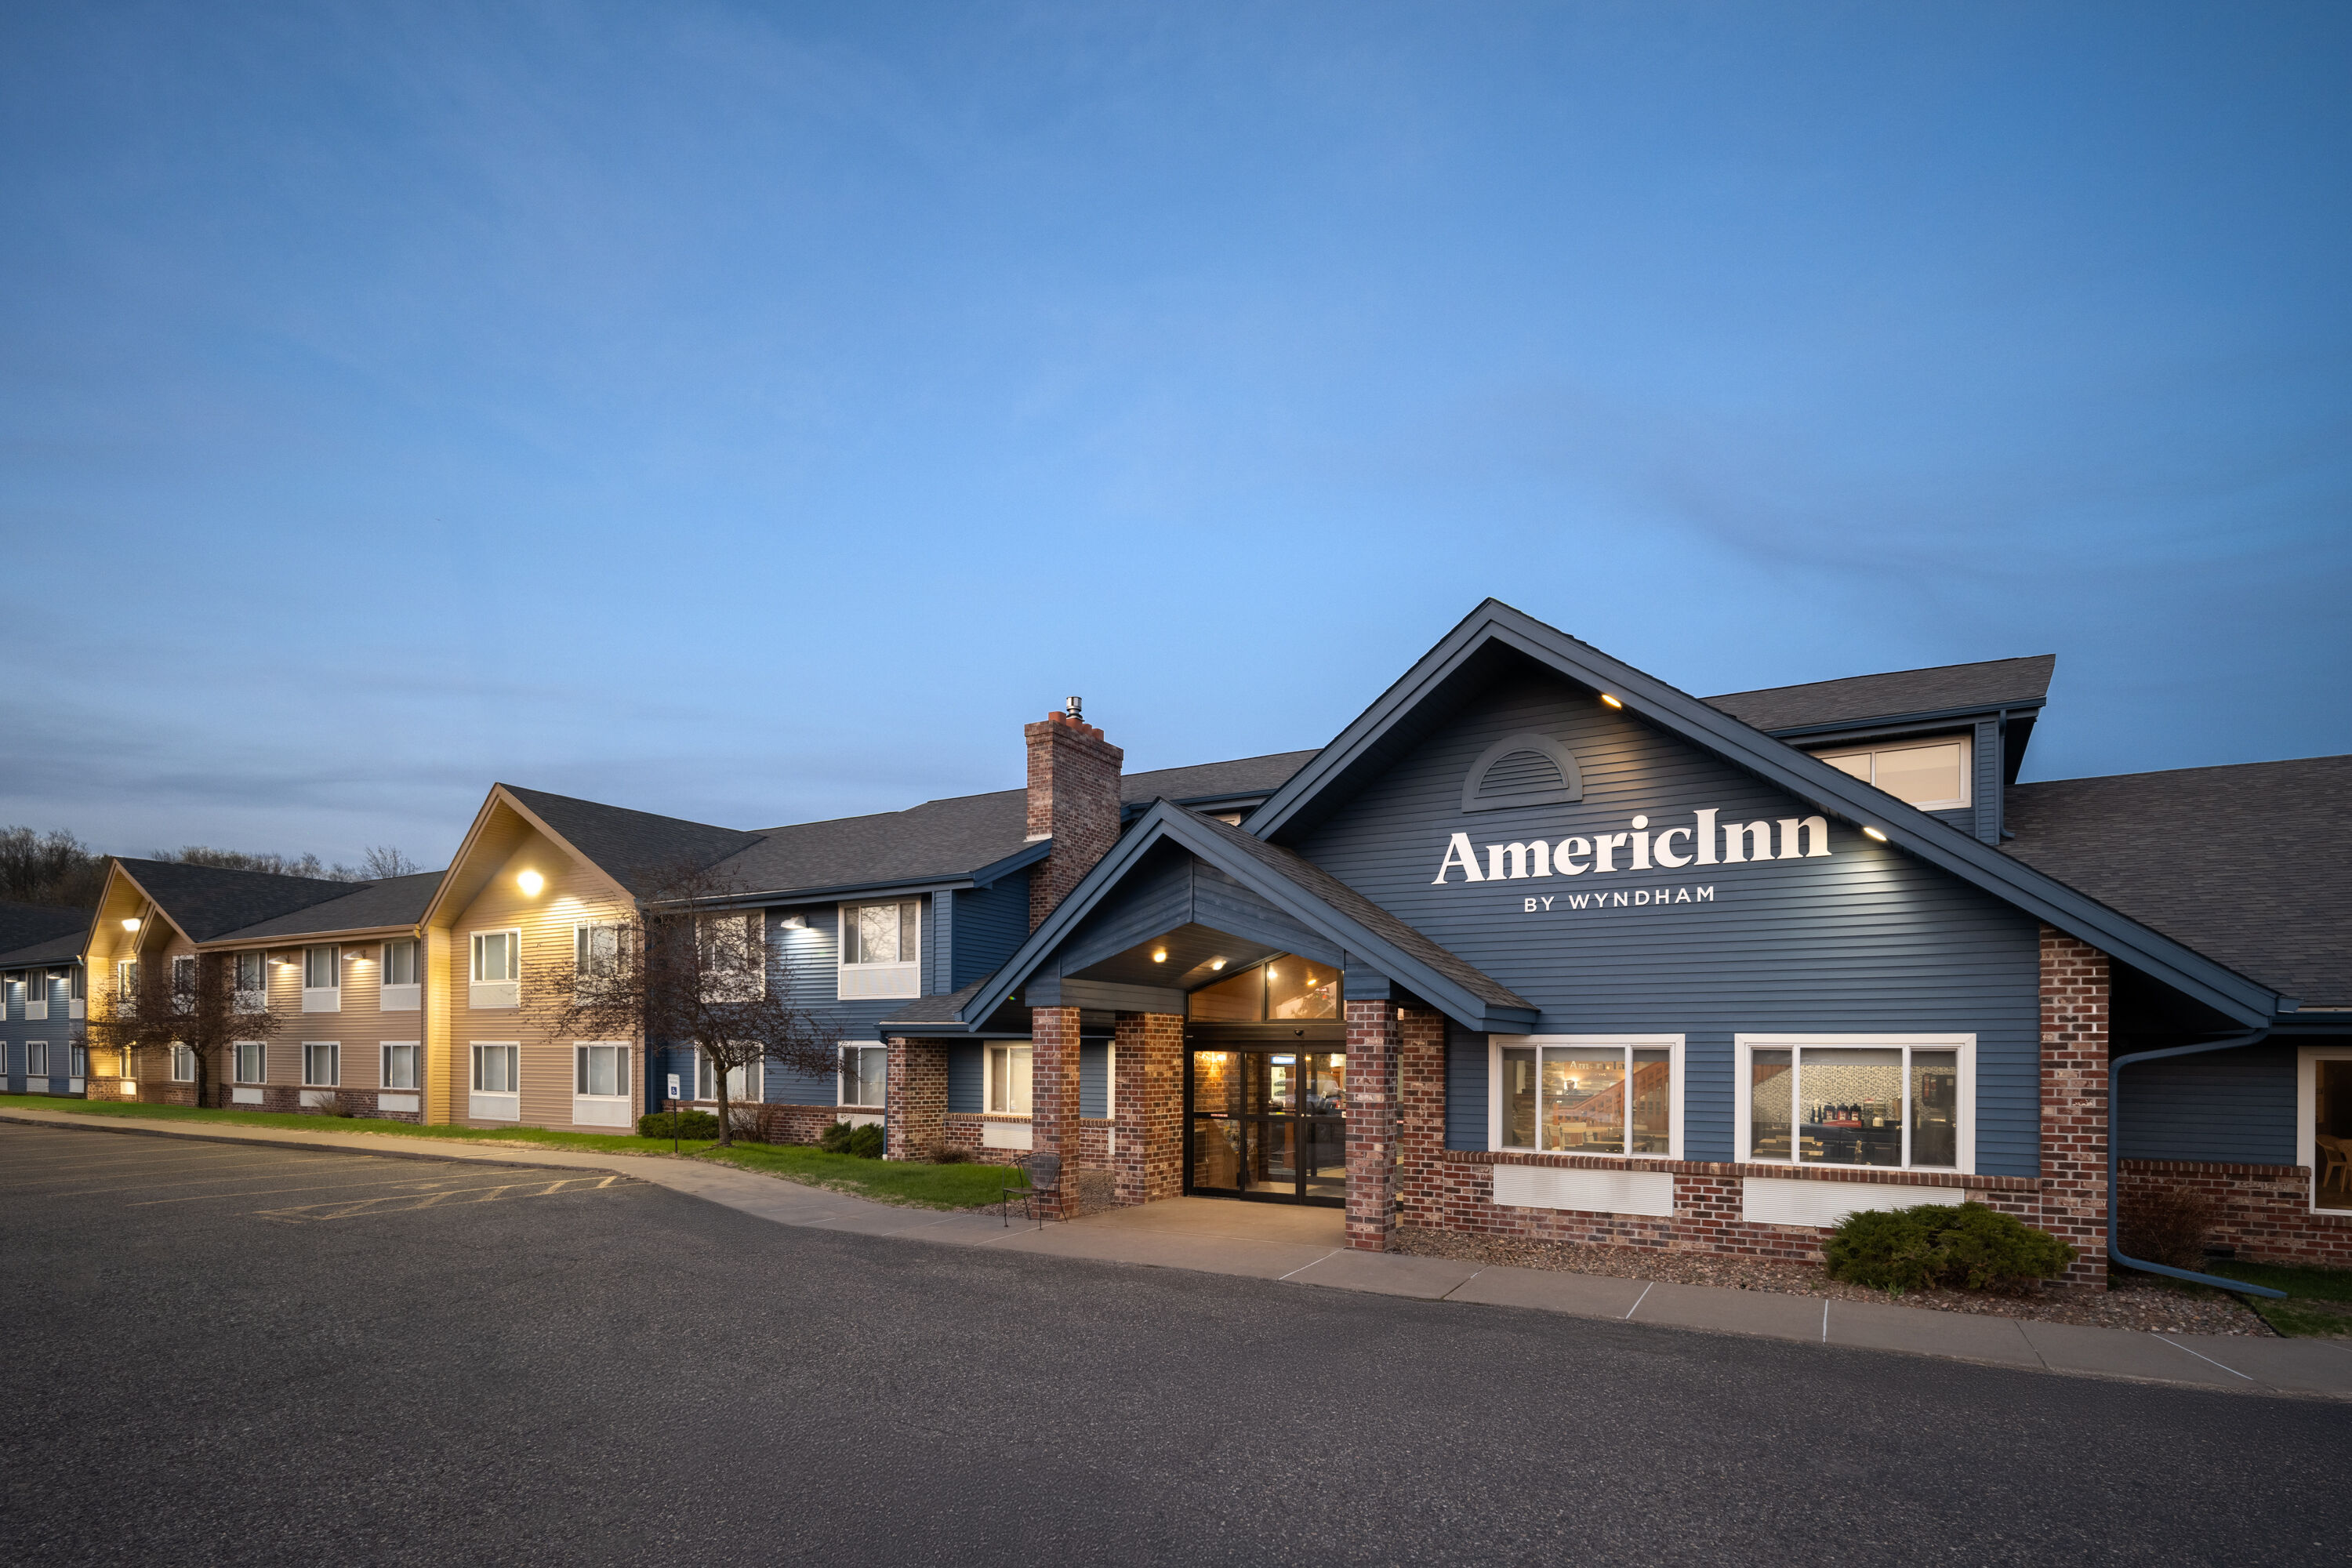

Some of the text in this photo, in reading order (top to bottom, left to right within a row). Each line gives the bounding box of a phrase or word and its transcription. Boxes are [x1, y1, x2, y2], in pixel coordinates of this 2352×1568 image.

[1432, 808, 1832, 884] AmericInn
[1524, 886, 1715, 912] BY WYNDHAM
